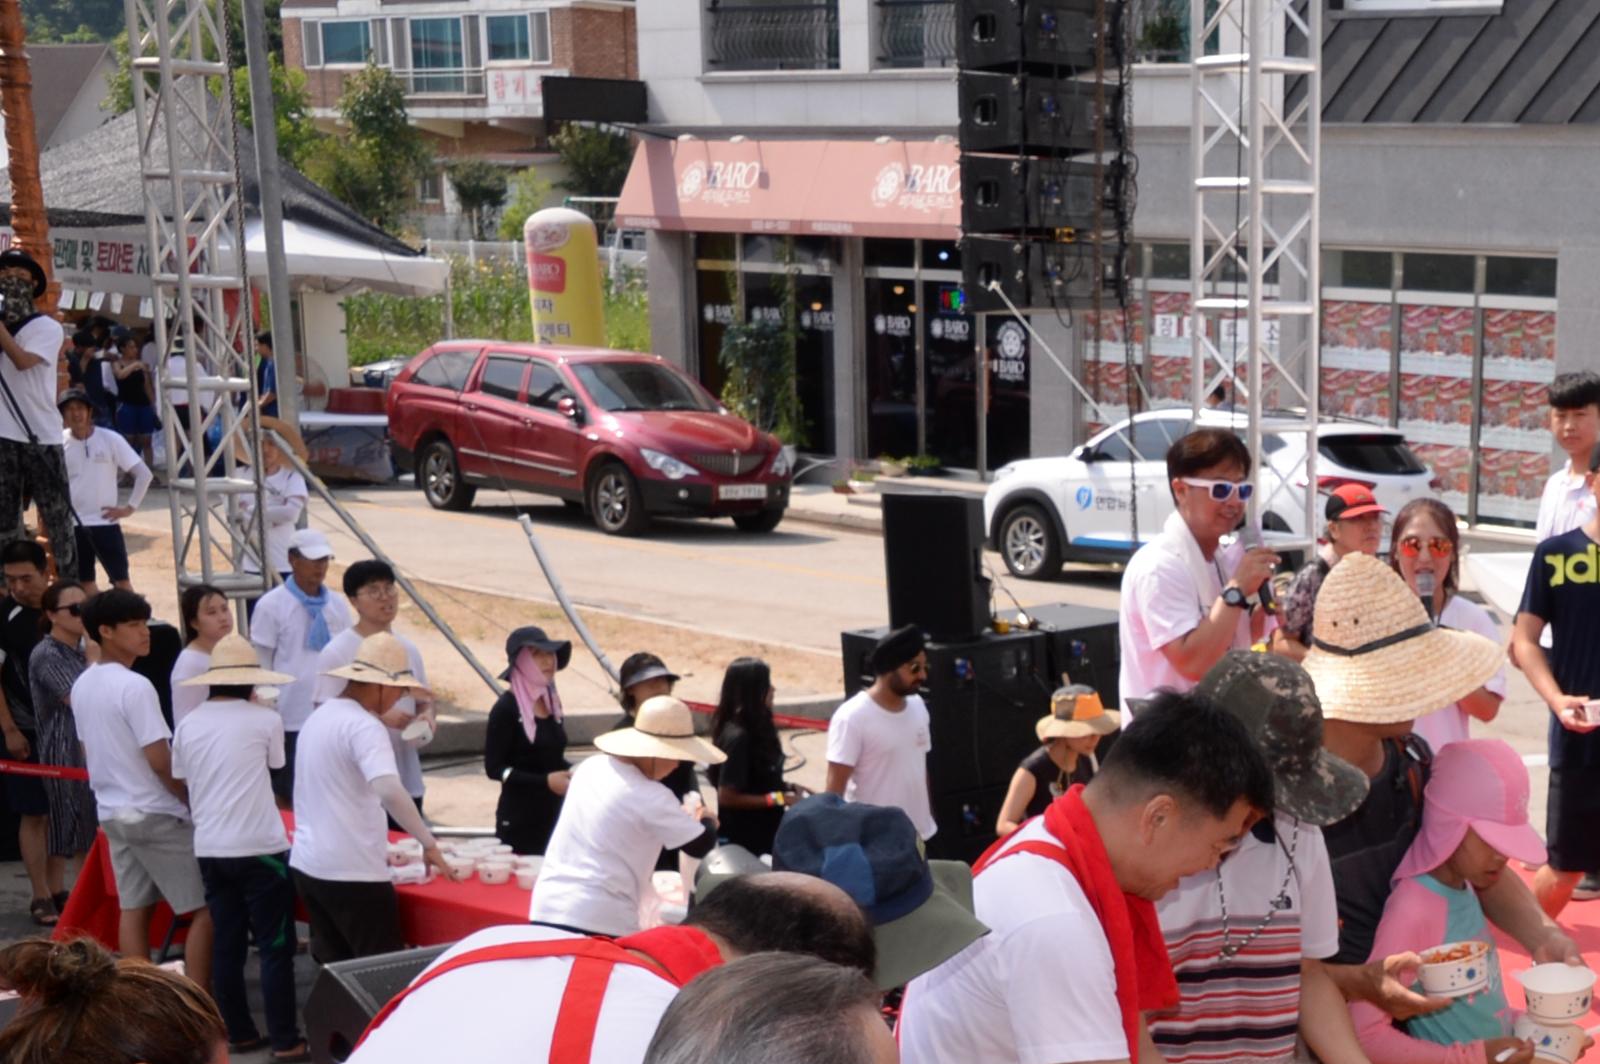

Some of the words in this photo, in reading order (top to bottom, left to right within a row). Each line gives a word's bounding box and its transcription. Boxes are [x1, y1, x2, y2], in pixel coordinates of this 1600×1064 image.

[709, 161, 761, 189] BARO
[54, 238, 78, 270] 판매
[81, 241, 94, 273] 및
[97, 241, 134, 274] 토마토
[999, 359, 1025, 374] BARO
